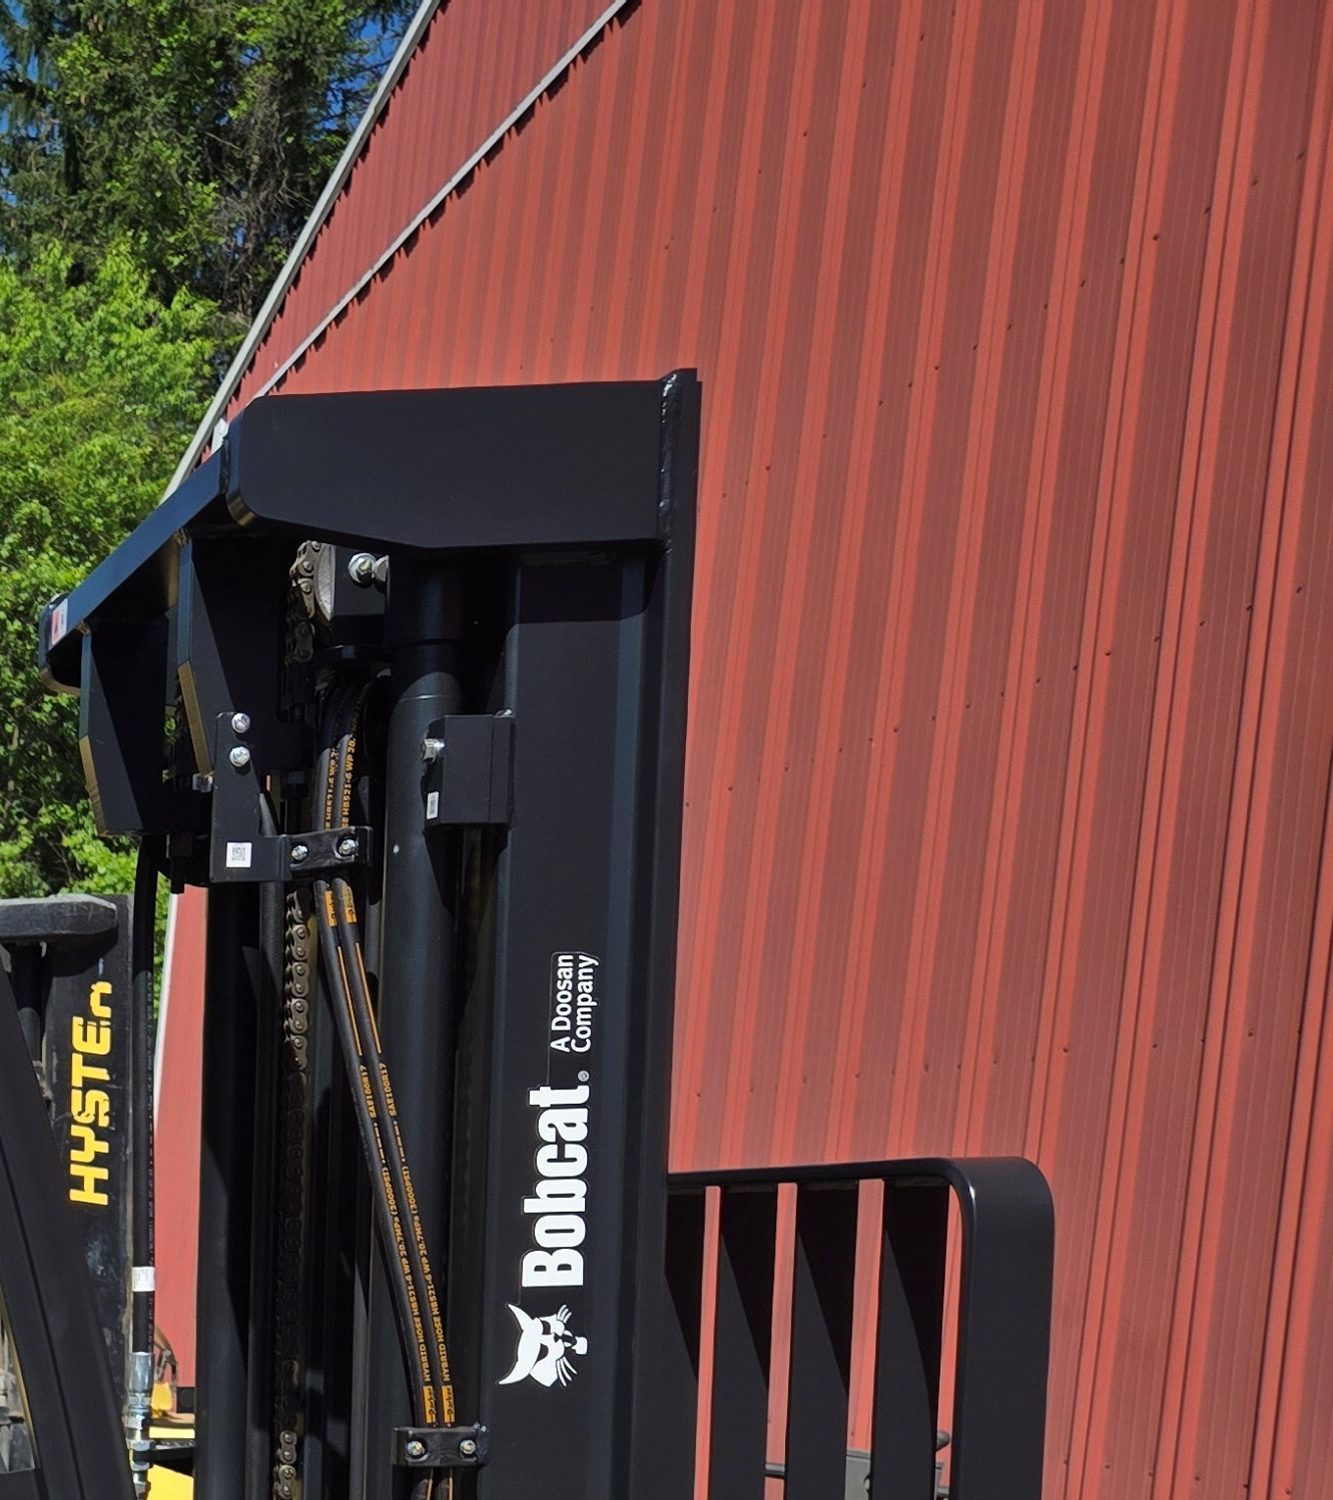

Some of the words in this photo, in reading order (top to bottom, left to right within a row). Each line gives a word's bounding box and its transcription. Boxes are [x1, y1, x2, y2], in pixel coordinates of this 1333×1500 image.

[552, 954, 574, 1031] Doosan
[571, 954, 600, 1053] Company
[551, 1037, 571, 1053] A
[521, 1085, 590, 1288] Bobcat
[401, 1257, 412, 1273] WP
[420, 1257, 431, 1273] WP
[413, 1316, 426, 1342] HOSE
[433, 1316, 445, 1342] HOSE
[419, 1344, 431, 1382] HYBRID
[438, 1343, 450, 1382] HYBRID
